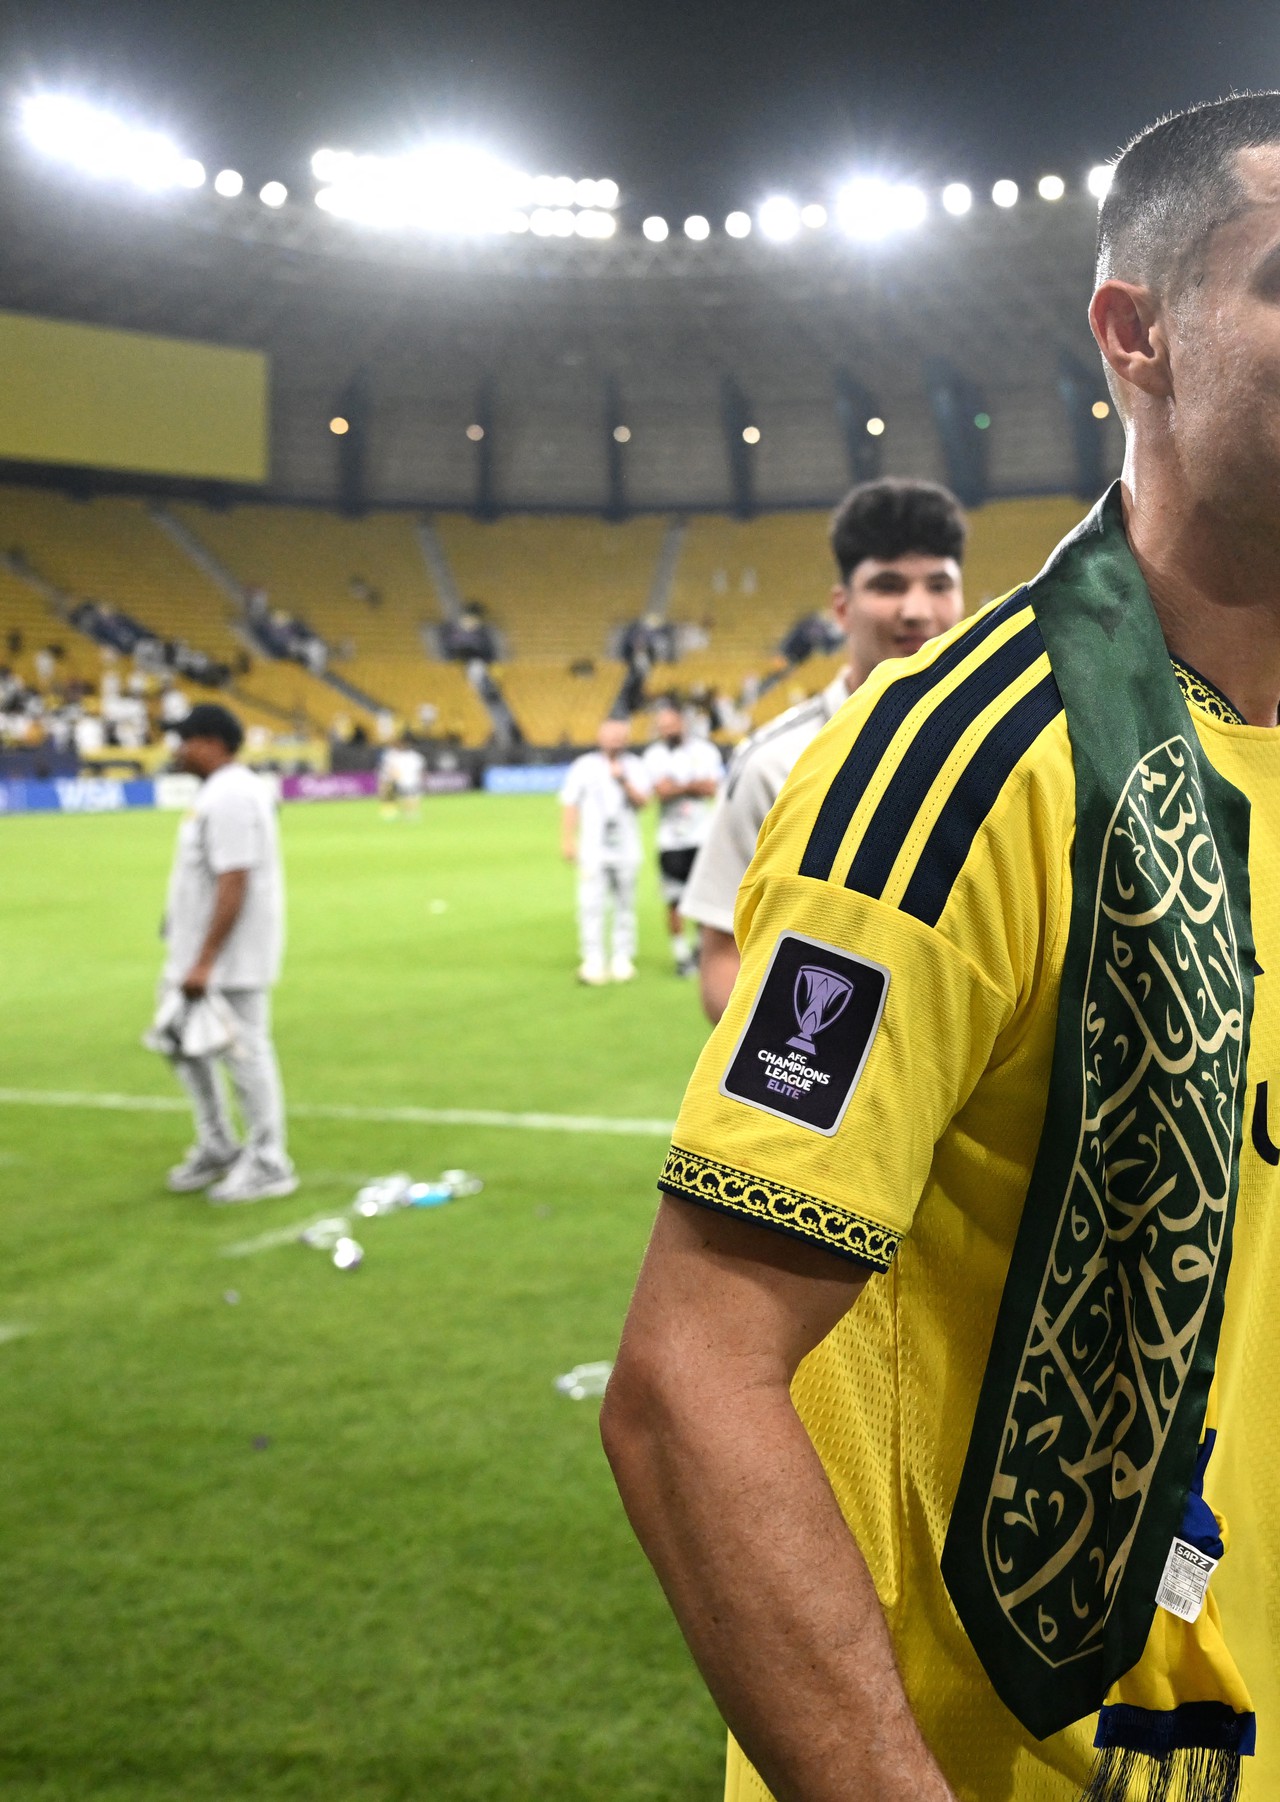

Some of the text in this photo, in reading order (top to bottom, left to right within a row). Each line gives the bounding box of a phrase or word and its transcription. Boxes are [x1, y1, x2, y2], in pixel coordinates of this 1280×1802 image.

[757, 1049, 830, 1085] CHAMPIONS
[788, 1051, 807, 1064] AFC
[765, 1065, 813, 1091] LEAGUE
[767, 1080, 800, 1099] ELITE
[1177, 1546, 1209, 1569] SARZ
